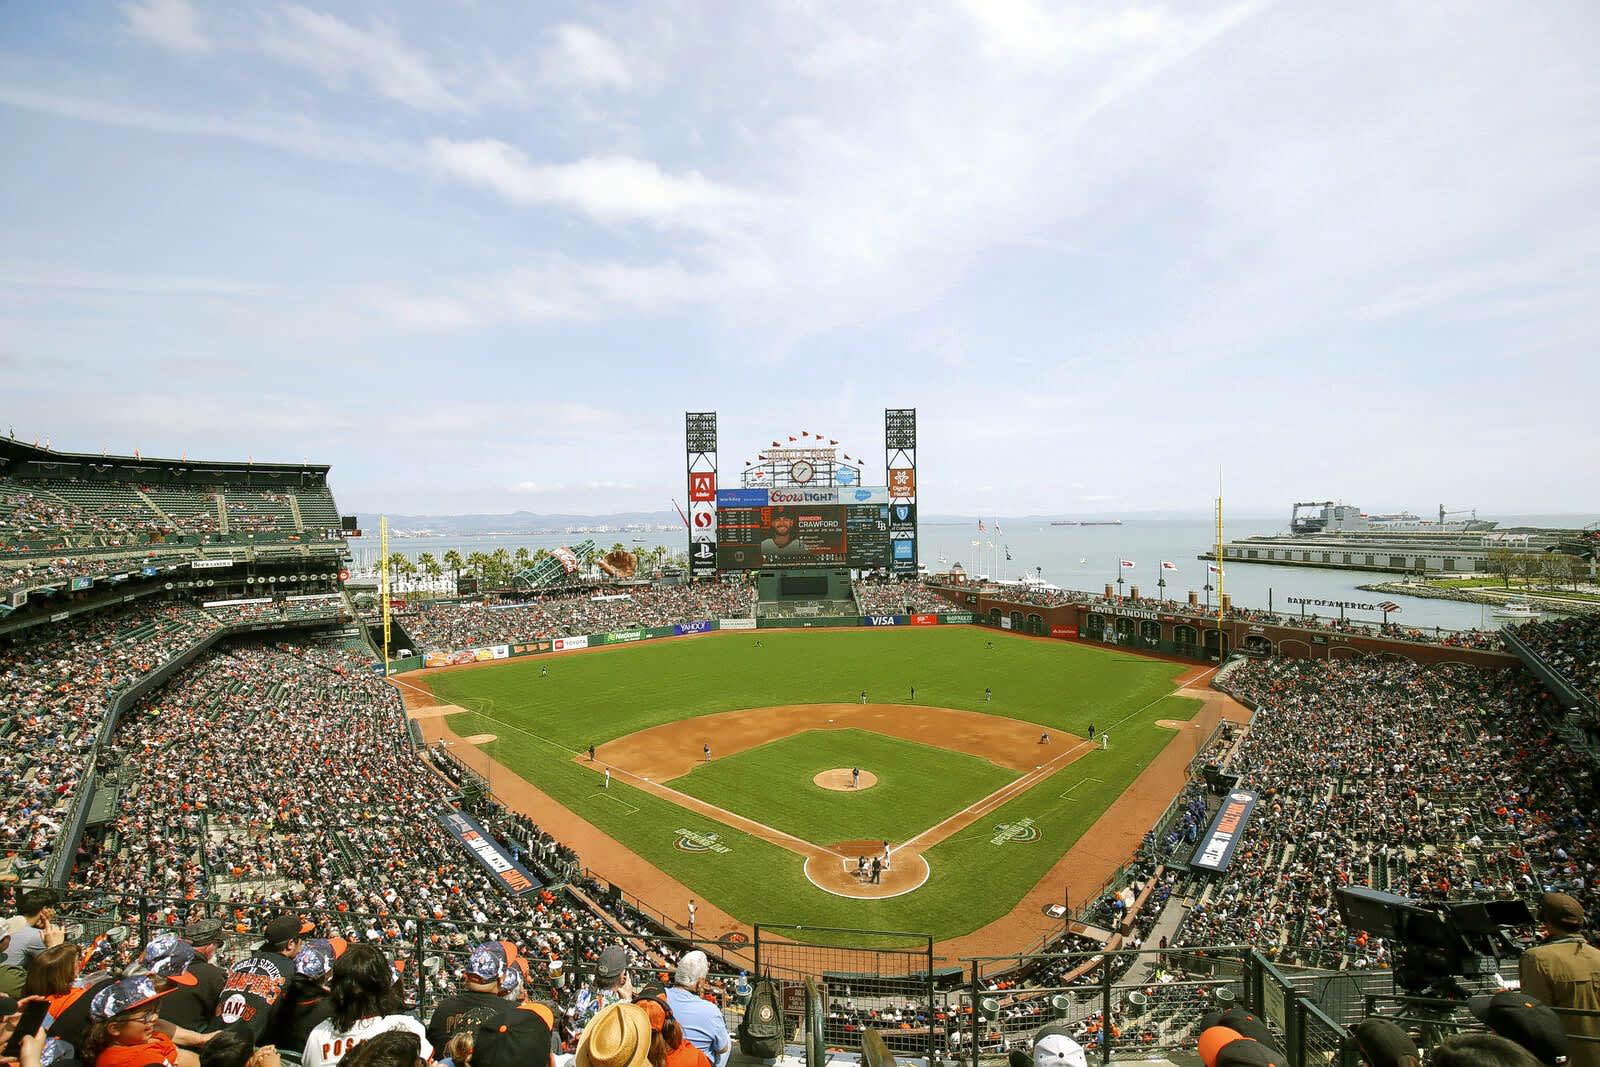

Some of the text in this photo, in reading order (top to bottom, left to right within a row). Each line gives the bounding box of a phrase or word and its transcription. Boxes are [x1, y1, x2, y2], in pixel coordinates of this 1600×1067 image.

[770, 490, 833, 502] Coors LIGHT
[798, 520, 839, 528] CRAWFORD
[1287, 596, 1375, 611] BANK OF AMERICA
[1116, 608, 1158, 621] LANDING
[871, 616, 895, 626] VISA
[615, 631, 641, 641] National
[565, 639, 587, 647] TOYOTA
